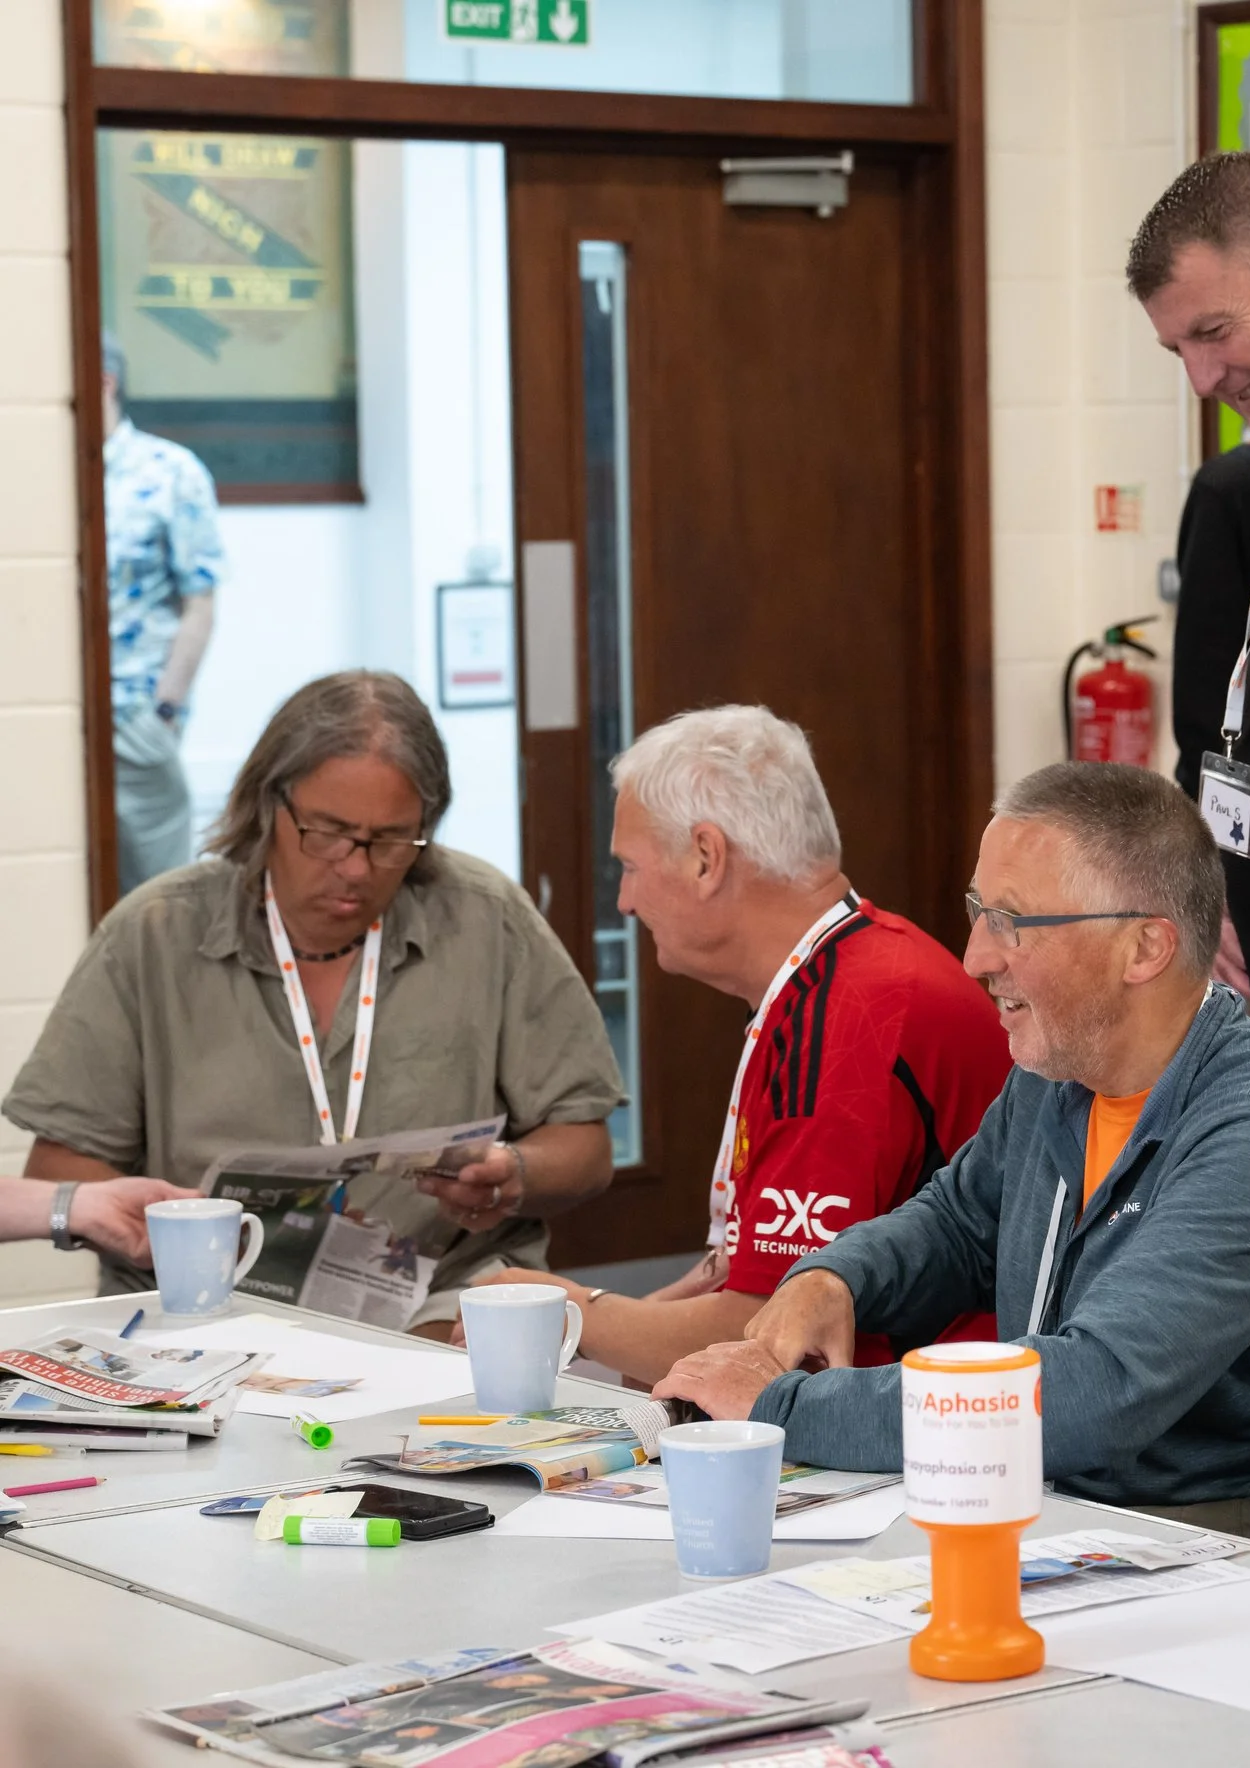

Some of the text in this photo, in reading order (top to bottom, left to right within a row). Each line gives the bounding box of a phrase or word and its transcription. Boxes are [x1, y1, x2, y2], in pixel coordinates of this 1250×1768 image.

[451, 3, 504, 29] EXIT
[1234, 807, 1241, 821] S
[754, 1187, 850, 1242] DXC
[0, 1356, 62, 1383] pretty
[36, 1359, 60, 1372] on
[62, 1367, 166, 1397] everything
[62, 1379, 119, 1399] share
